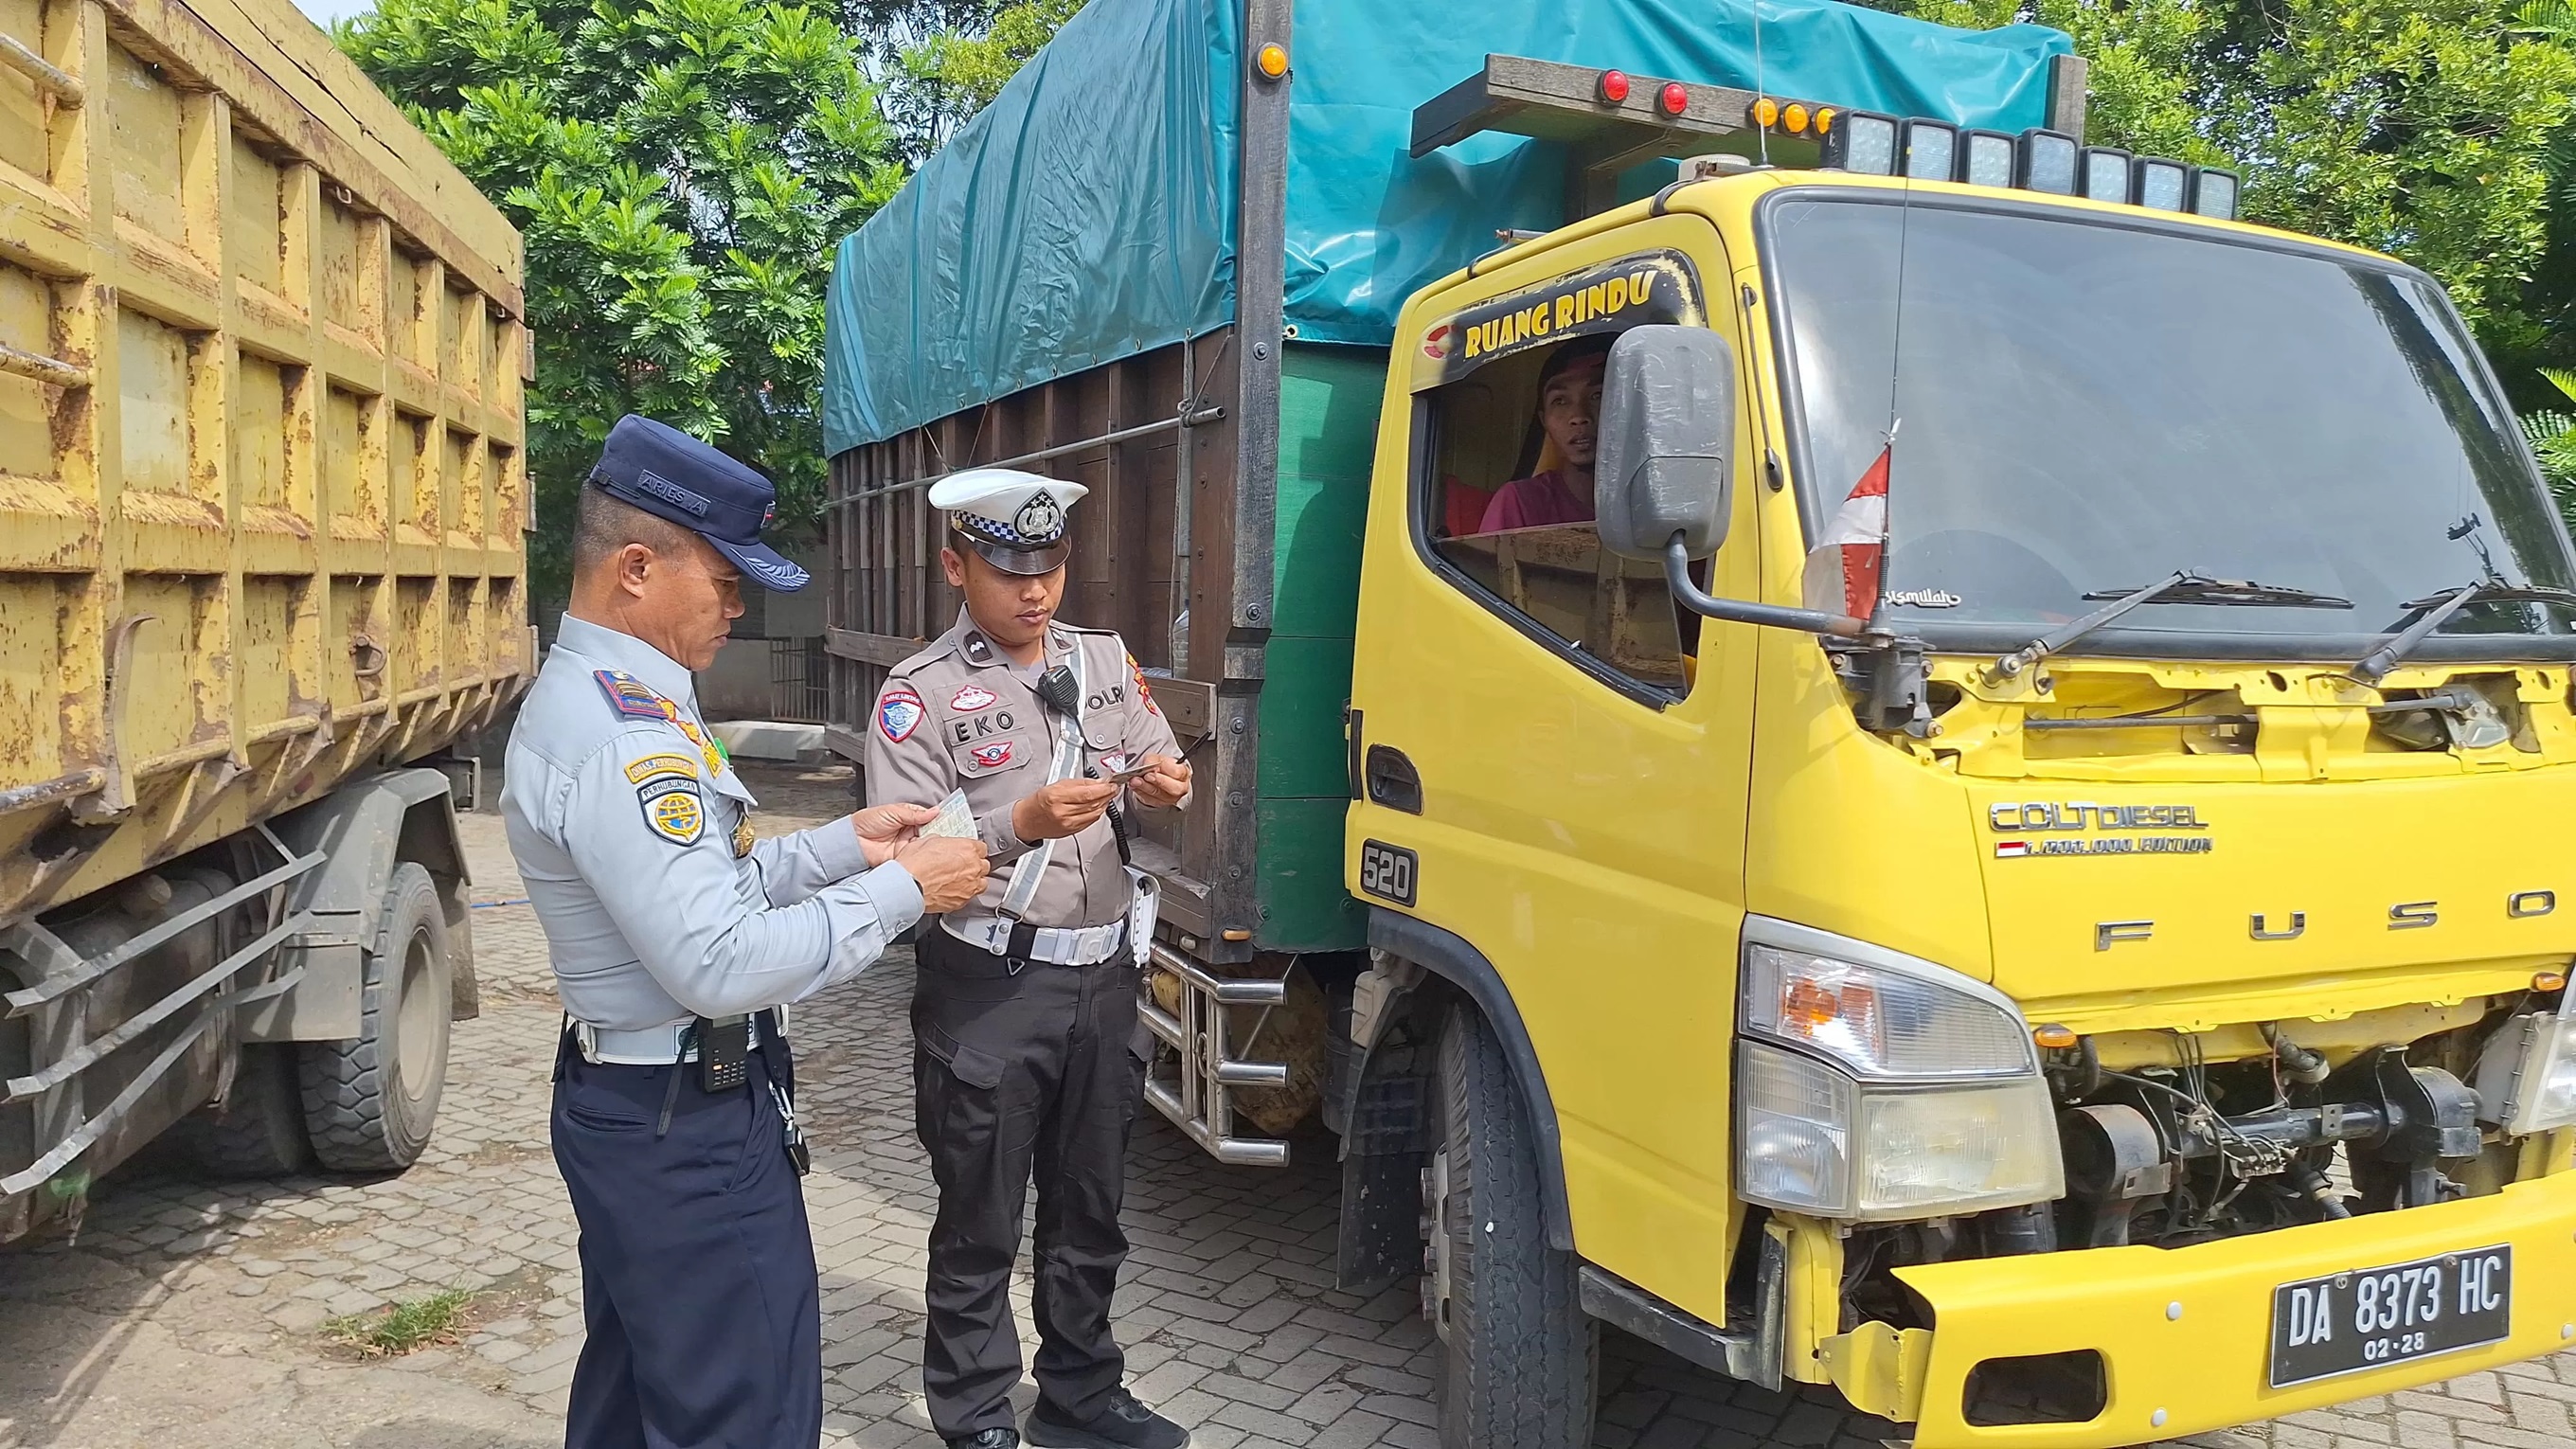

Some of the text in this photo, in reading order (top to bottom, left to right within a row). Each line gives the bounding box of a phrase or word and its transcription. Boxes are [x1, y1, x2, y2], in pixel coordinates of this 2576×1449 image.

[1464, 270, 1658, 359] RUANG RINDU
[641, 477, 686, 504] ARIES
[1087, 685, 1124, 709] OLRI
[955, 710, 1014, 742] EKO
[643, 779, 695, 797] PERHUBUNGAN
[2139, 836, 2213, 852] EDITION
[1364, 846, 1410, 899] 520
[2288, 1254, 2503, 1348] DA 8373 HC
